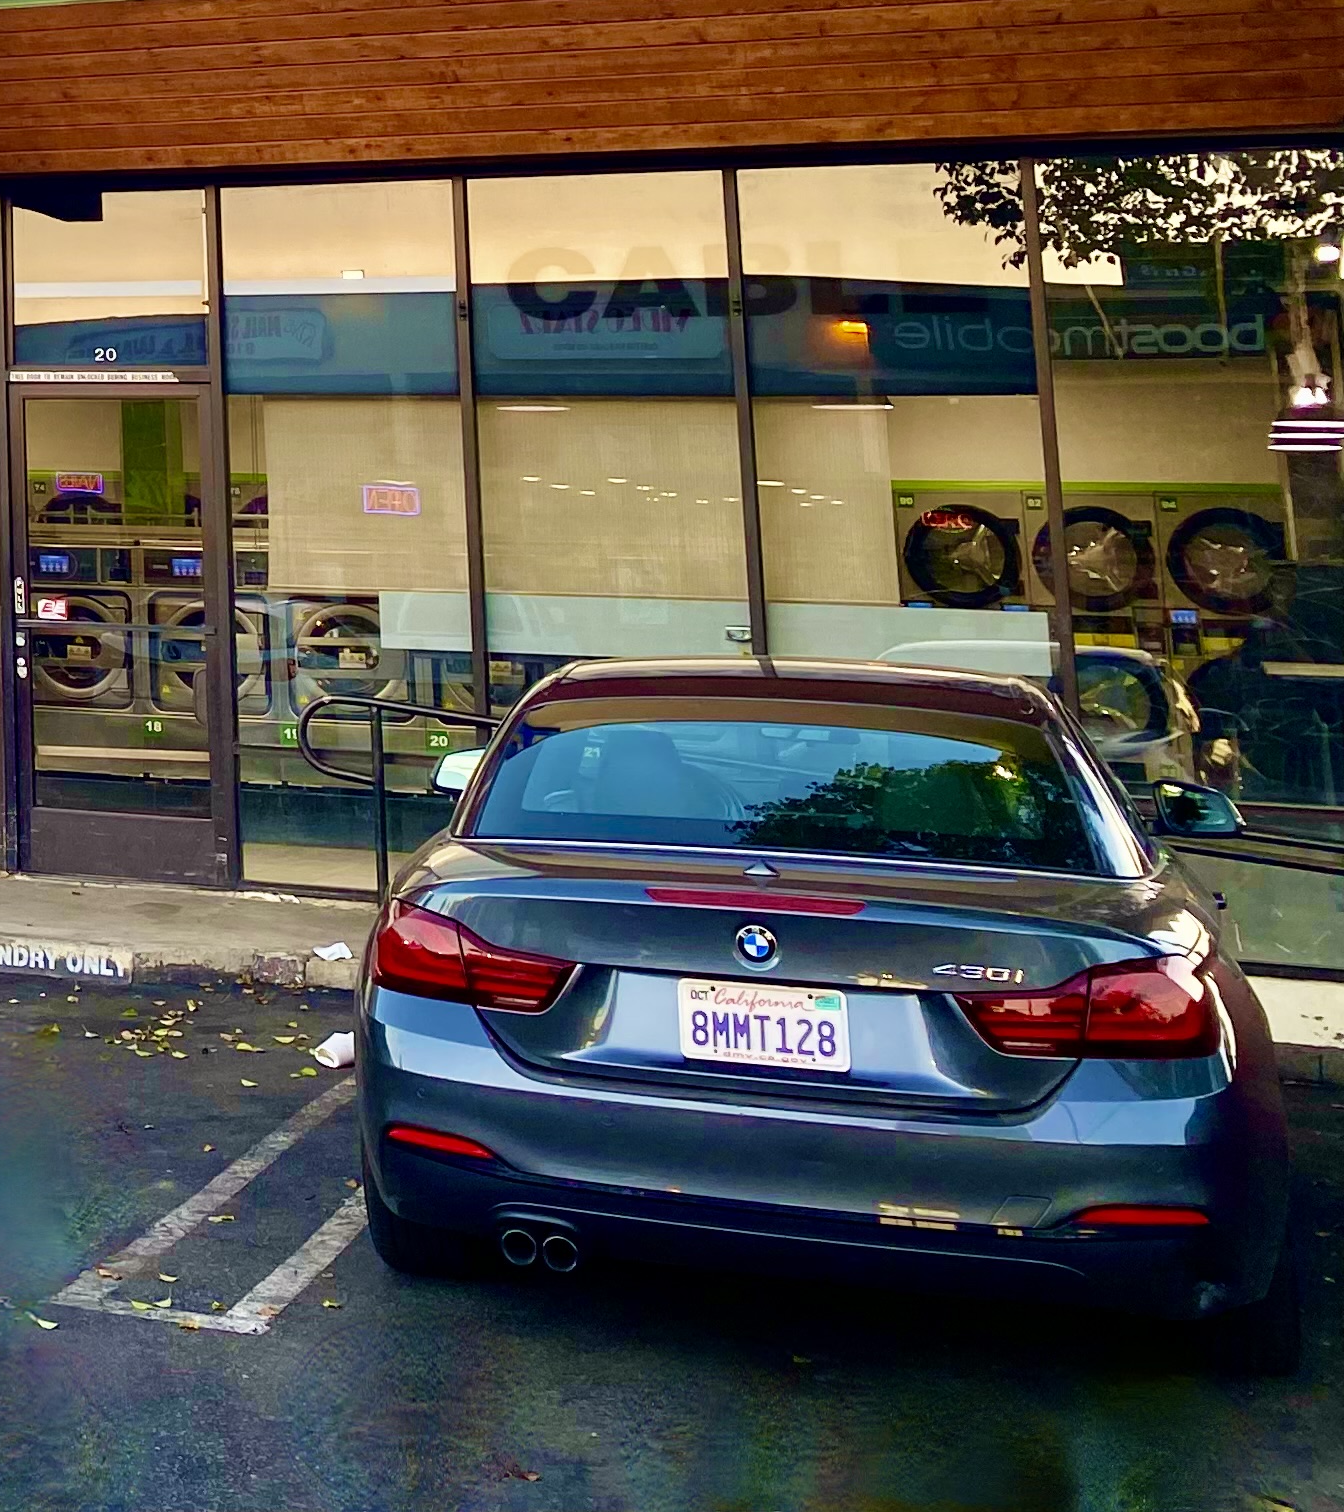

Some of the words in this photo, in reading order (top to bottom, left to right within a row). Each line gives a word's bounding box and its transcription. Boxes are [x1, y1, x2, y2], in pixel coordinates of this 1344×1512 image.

[94, 348, 117, 362] 20
[145, 720, 162, 732] 18
[430, 735, 449, 747] 20
[66, 948, 129, 978] ONLY
[932, 963, 1025, 985] 430i
[690, 989, 709, 1001] OCT
[714, 987, 816, 1013] California
[691, 1010, 837, 1057] 8MMT128
[722, 1051, 808, 1065] dmv.ca.gov
